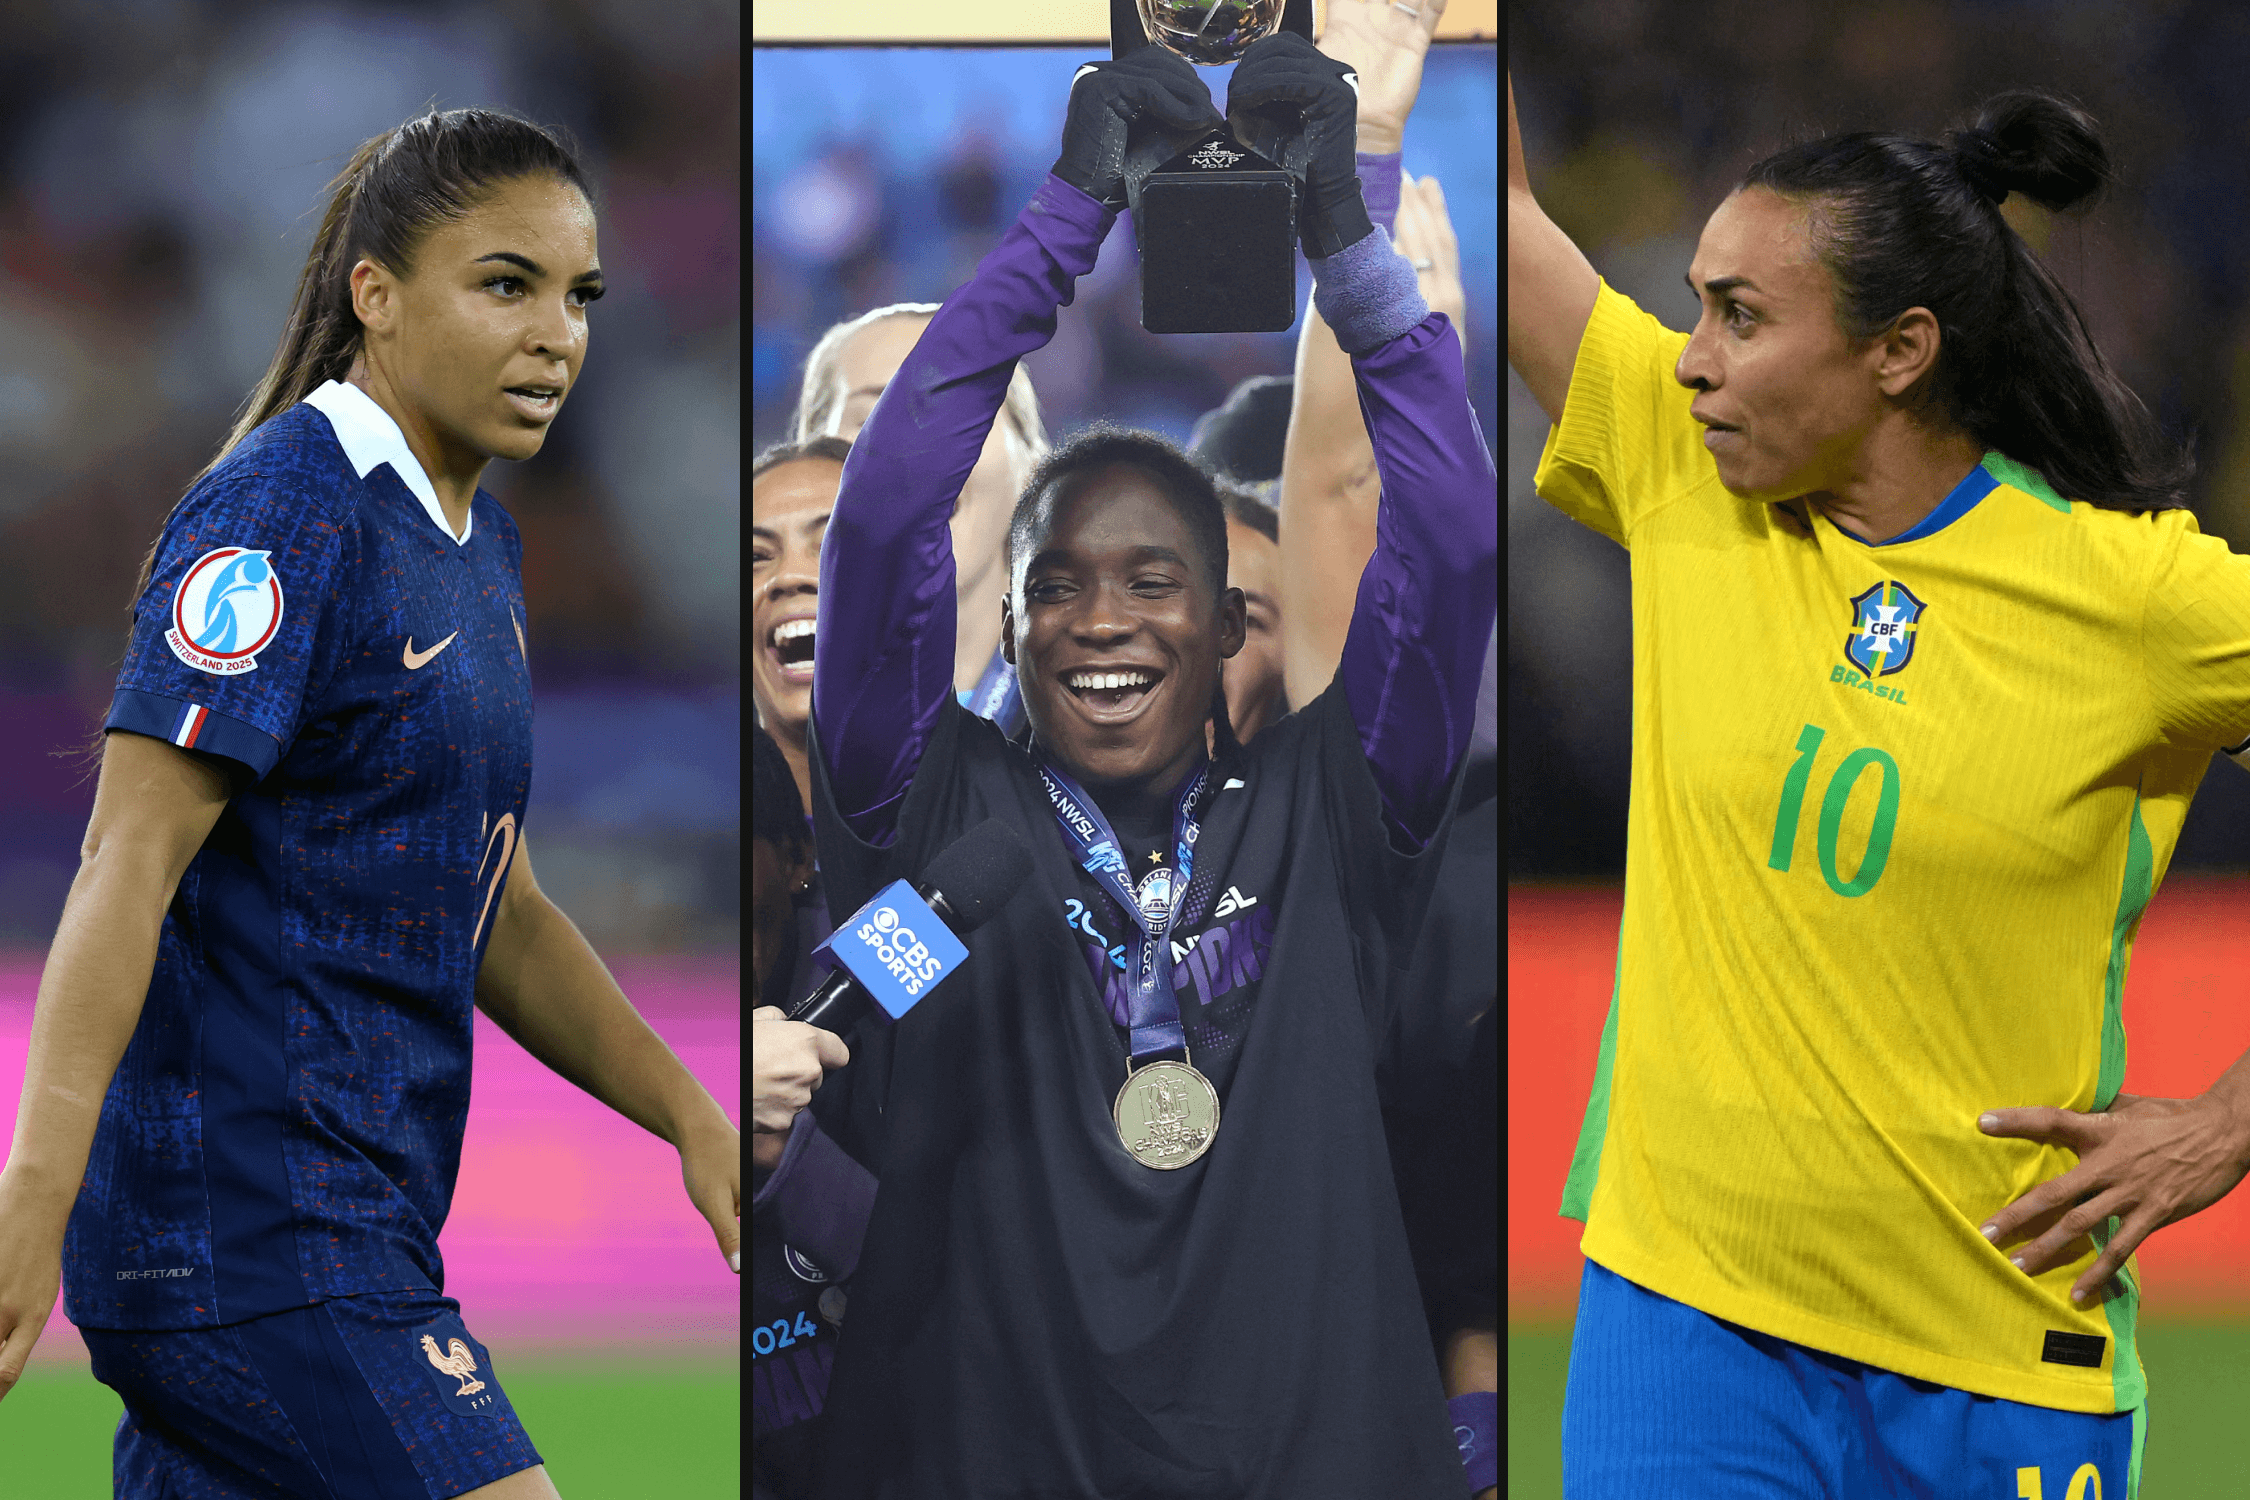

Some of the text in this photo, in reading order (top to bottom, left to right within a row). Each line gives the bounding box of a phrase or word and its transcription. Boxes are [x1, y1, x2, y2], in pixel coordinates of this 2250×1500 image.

[1191, 157, 1240, 165] MVP
[1871, 622, 1898, 636] CBF
[169, 630, 252, 671] SWITZERLAND 2025
[1829, 664, 1907, 705] BRASIL
[1057, 797, 1096, 842] NWSL
[1767, 722, 1900, 898] 10
[1138, 871, 1171, 893] ORLAN
[1148, 922, 1167, 932] RID
[857, 923, 924, 995] SPORTS
[891, 927, 942, 981] CBS
[1141, 941, 1152, 974] 202
[753, 1311, 817, 1359] 024
